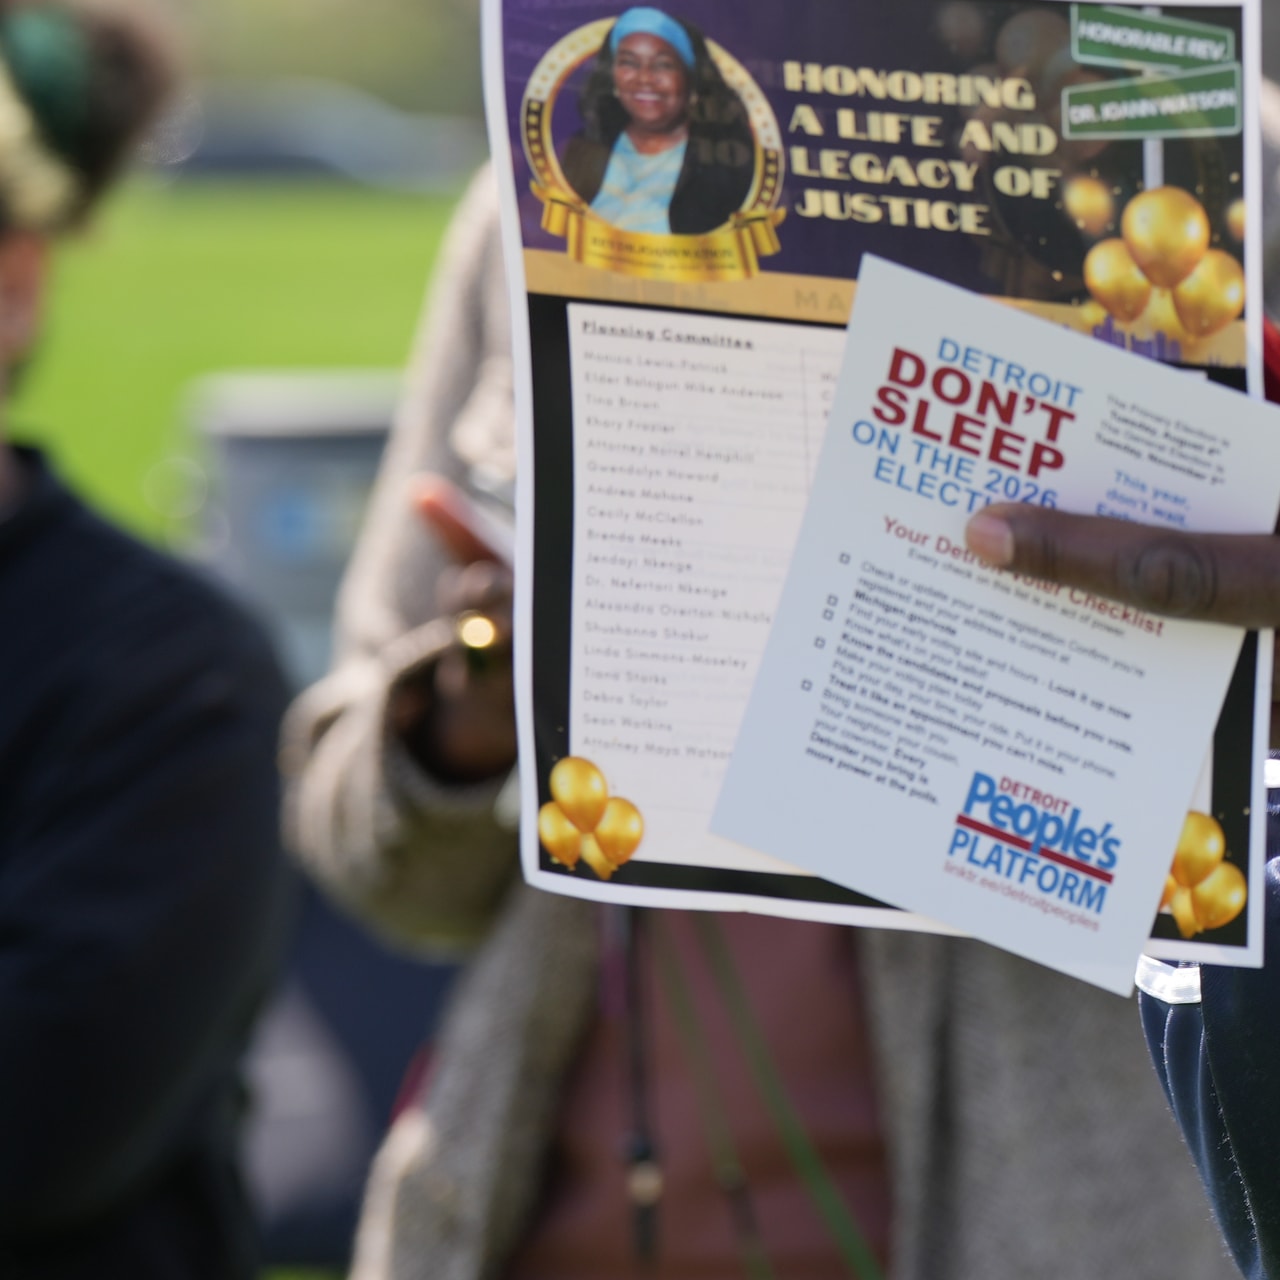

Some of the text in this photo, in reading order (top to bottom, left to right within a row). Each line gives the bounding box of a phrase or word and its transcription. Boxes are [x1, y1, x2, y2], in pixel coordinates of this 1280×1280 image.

[1077, 18, 1186, 58] HONORABLE
[782, 60, 1036, 111] HONORING
[1157, 87, 1238, 115] WATSON
[788, 103, 1058, 156] A LIFE AND
[789, 145, 1062, 200] LEGACY OF
[794, 187, 992, 236] JUSTICE
[887, 347, 1076, 443] DON'T
[937, 337, 1083, 408] DETROIT
[872, 386, 1065, 478] SLEEP
[852, 420, 901, 456] ON
[912, 439, 976, 483] THE
[984, 467, 1059, 511] 2026
[1067, 588, 1166, 636] Checklist
[963, 771, 1121, 870] People's
[997, 776, 1071, 815] DETROIT
[948, 827, 1108, 914] PLATFORM
